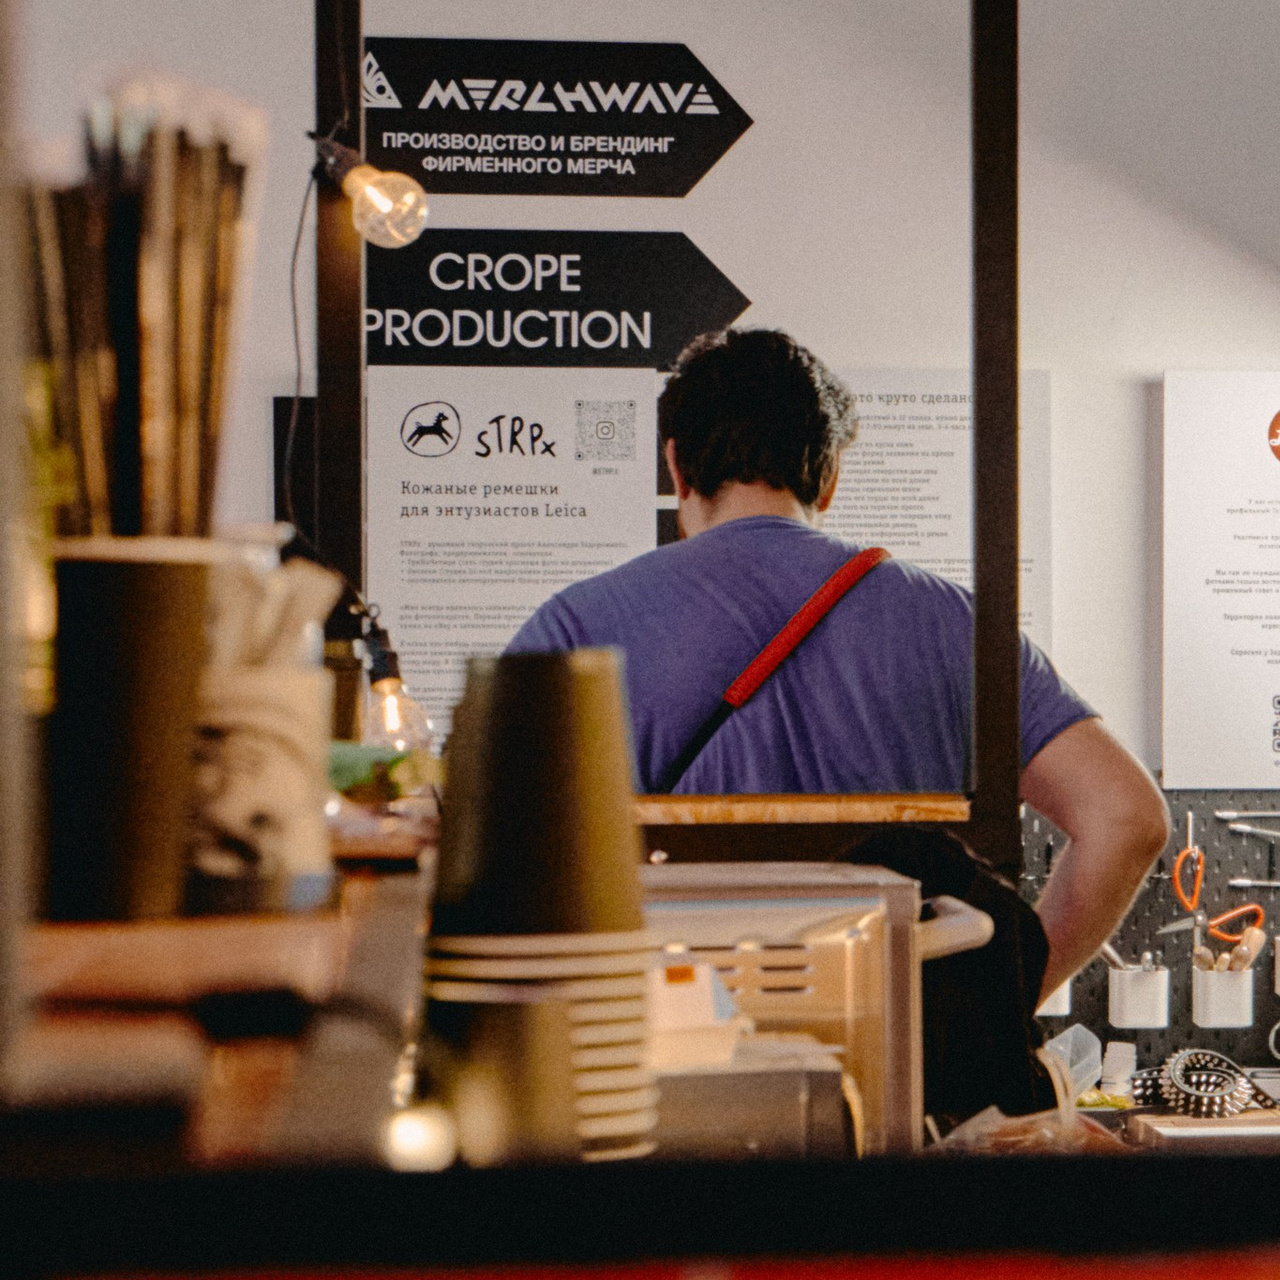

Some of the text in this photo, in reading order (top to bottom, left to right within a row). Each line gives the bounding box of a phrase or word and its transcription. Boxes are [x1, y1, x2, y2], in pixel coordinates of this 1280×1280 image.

[382, 132, 675, 154] ПРОИЗВОДСТВО И БРЕНДИНГ
[422, 156, 636, 175] ФИРМЕННОГО МЕРЧА
[429, 252, 581, 292] CROPE
[363, 308, 651, 349] PRODUCTION
[878, 394, 917, 407] круто
[401, 481, 559, 498] Кожаные ремешки
[400, 503, 587, 520] для энтузиастов Leica
